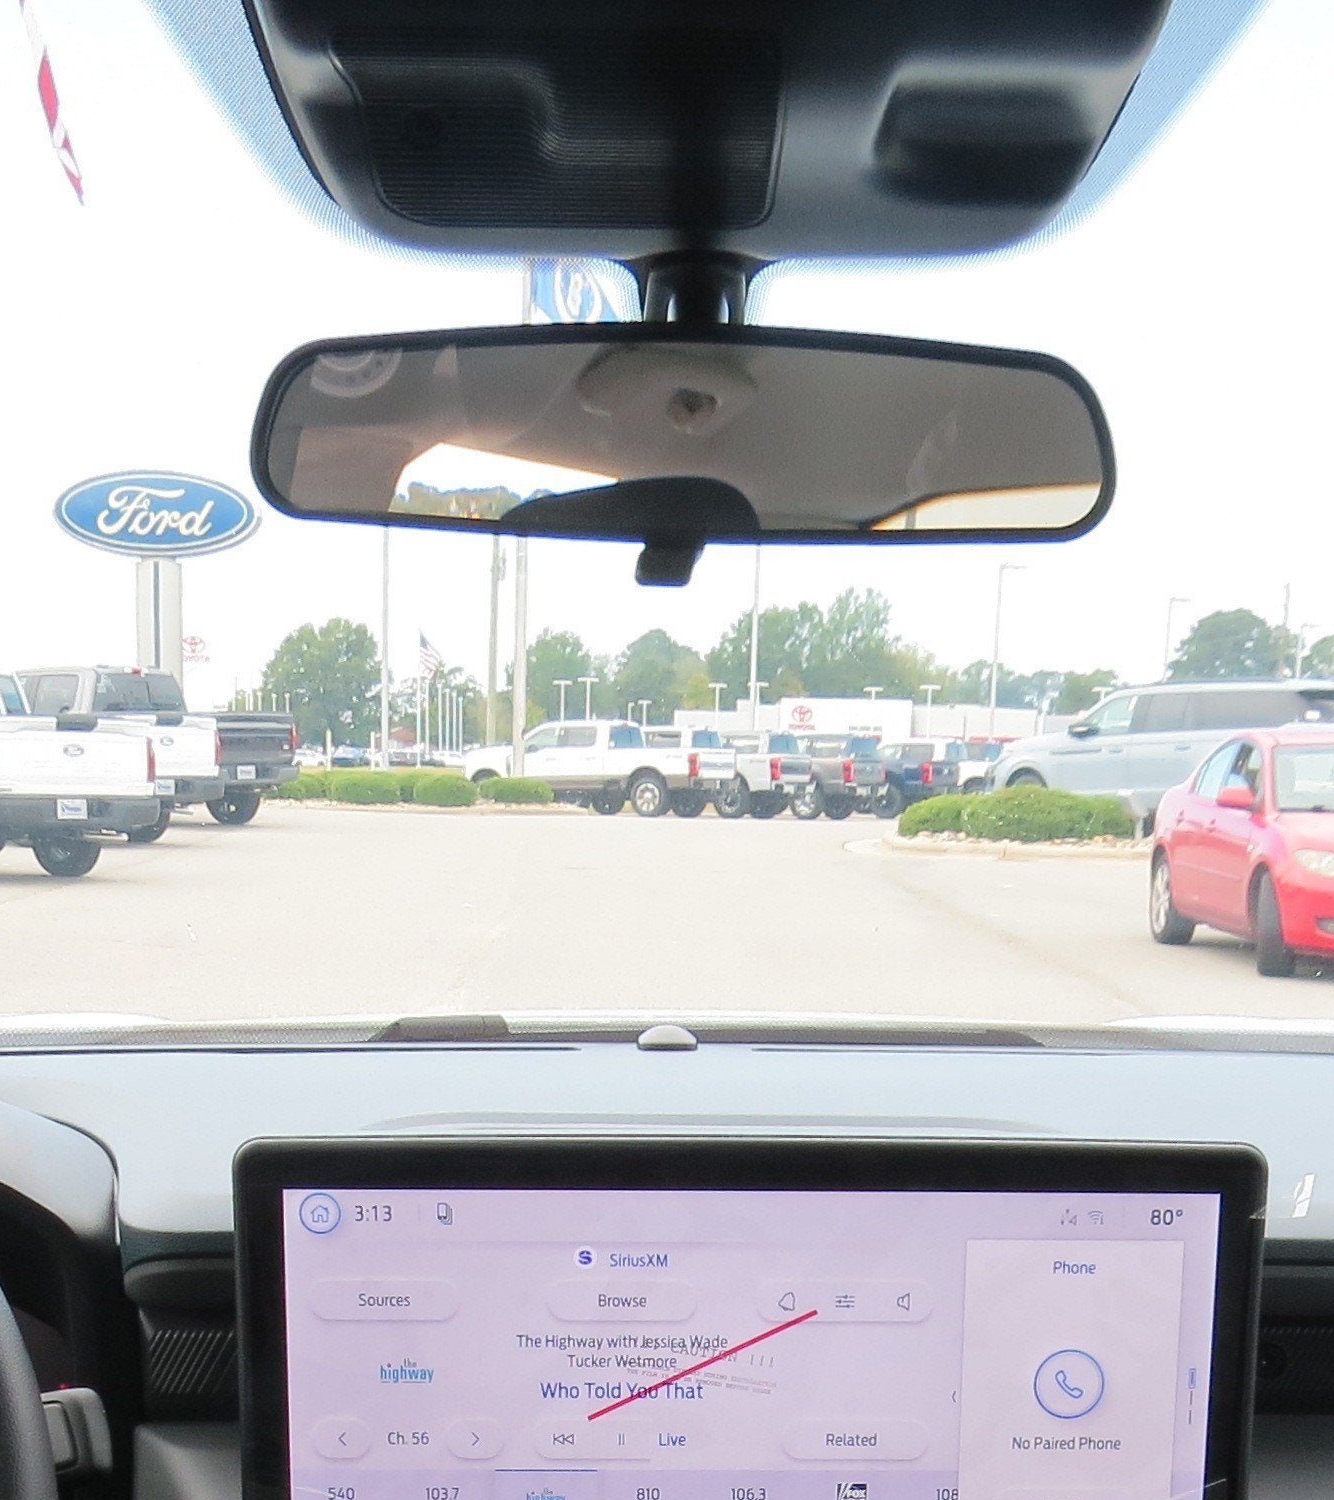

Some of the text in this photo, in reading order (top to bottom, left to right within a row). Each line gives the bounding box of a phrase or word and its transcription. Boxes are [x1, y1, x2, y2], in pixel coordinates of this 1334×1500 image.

[97, 483, 213, 536] Ford
[354, 1205, 393, 1222] 3:13
[1150, 1208, 1184, 1226] 80°
[609, 1253, 668, 1268] SiriusXM
[1052, 1259, 1097, 1276] Phone
[358, 1293, 411, 1308] Sources
[597, 1294, 648, 1308] Browse
[517, 1335, 728, 1350] The Highway with Jessica Wade
[568, 1354, 678, 1368] Tucker Wetmore
[380, 1365, 434, 1383] highway
[540, 1382, 704, 1399] Who Told You That
[387, 1431, 430, 1445] Ch. 56
[658, 1433, 687, 1447] Live
[825, 1432, 878, 1447] Related
[1012, 1437, 1122, 1451] No Paired Phone
[327, 1487, 355, 1500] 540
[425, 1487, 460, 1500] 103.7
[636, 1488, 661, 1500] 810
[730, 1488, 767, 1500] 106.3
[847, 1489, 867, 1498] FOX
